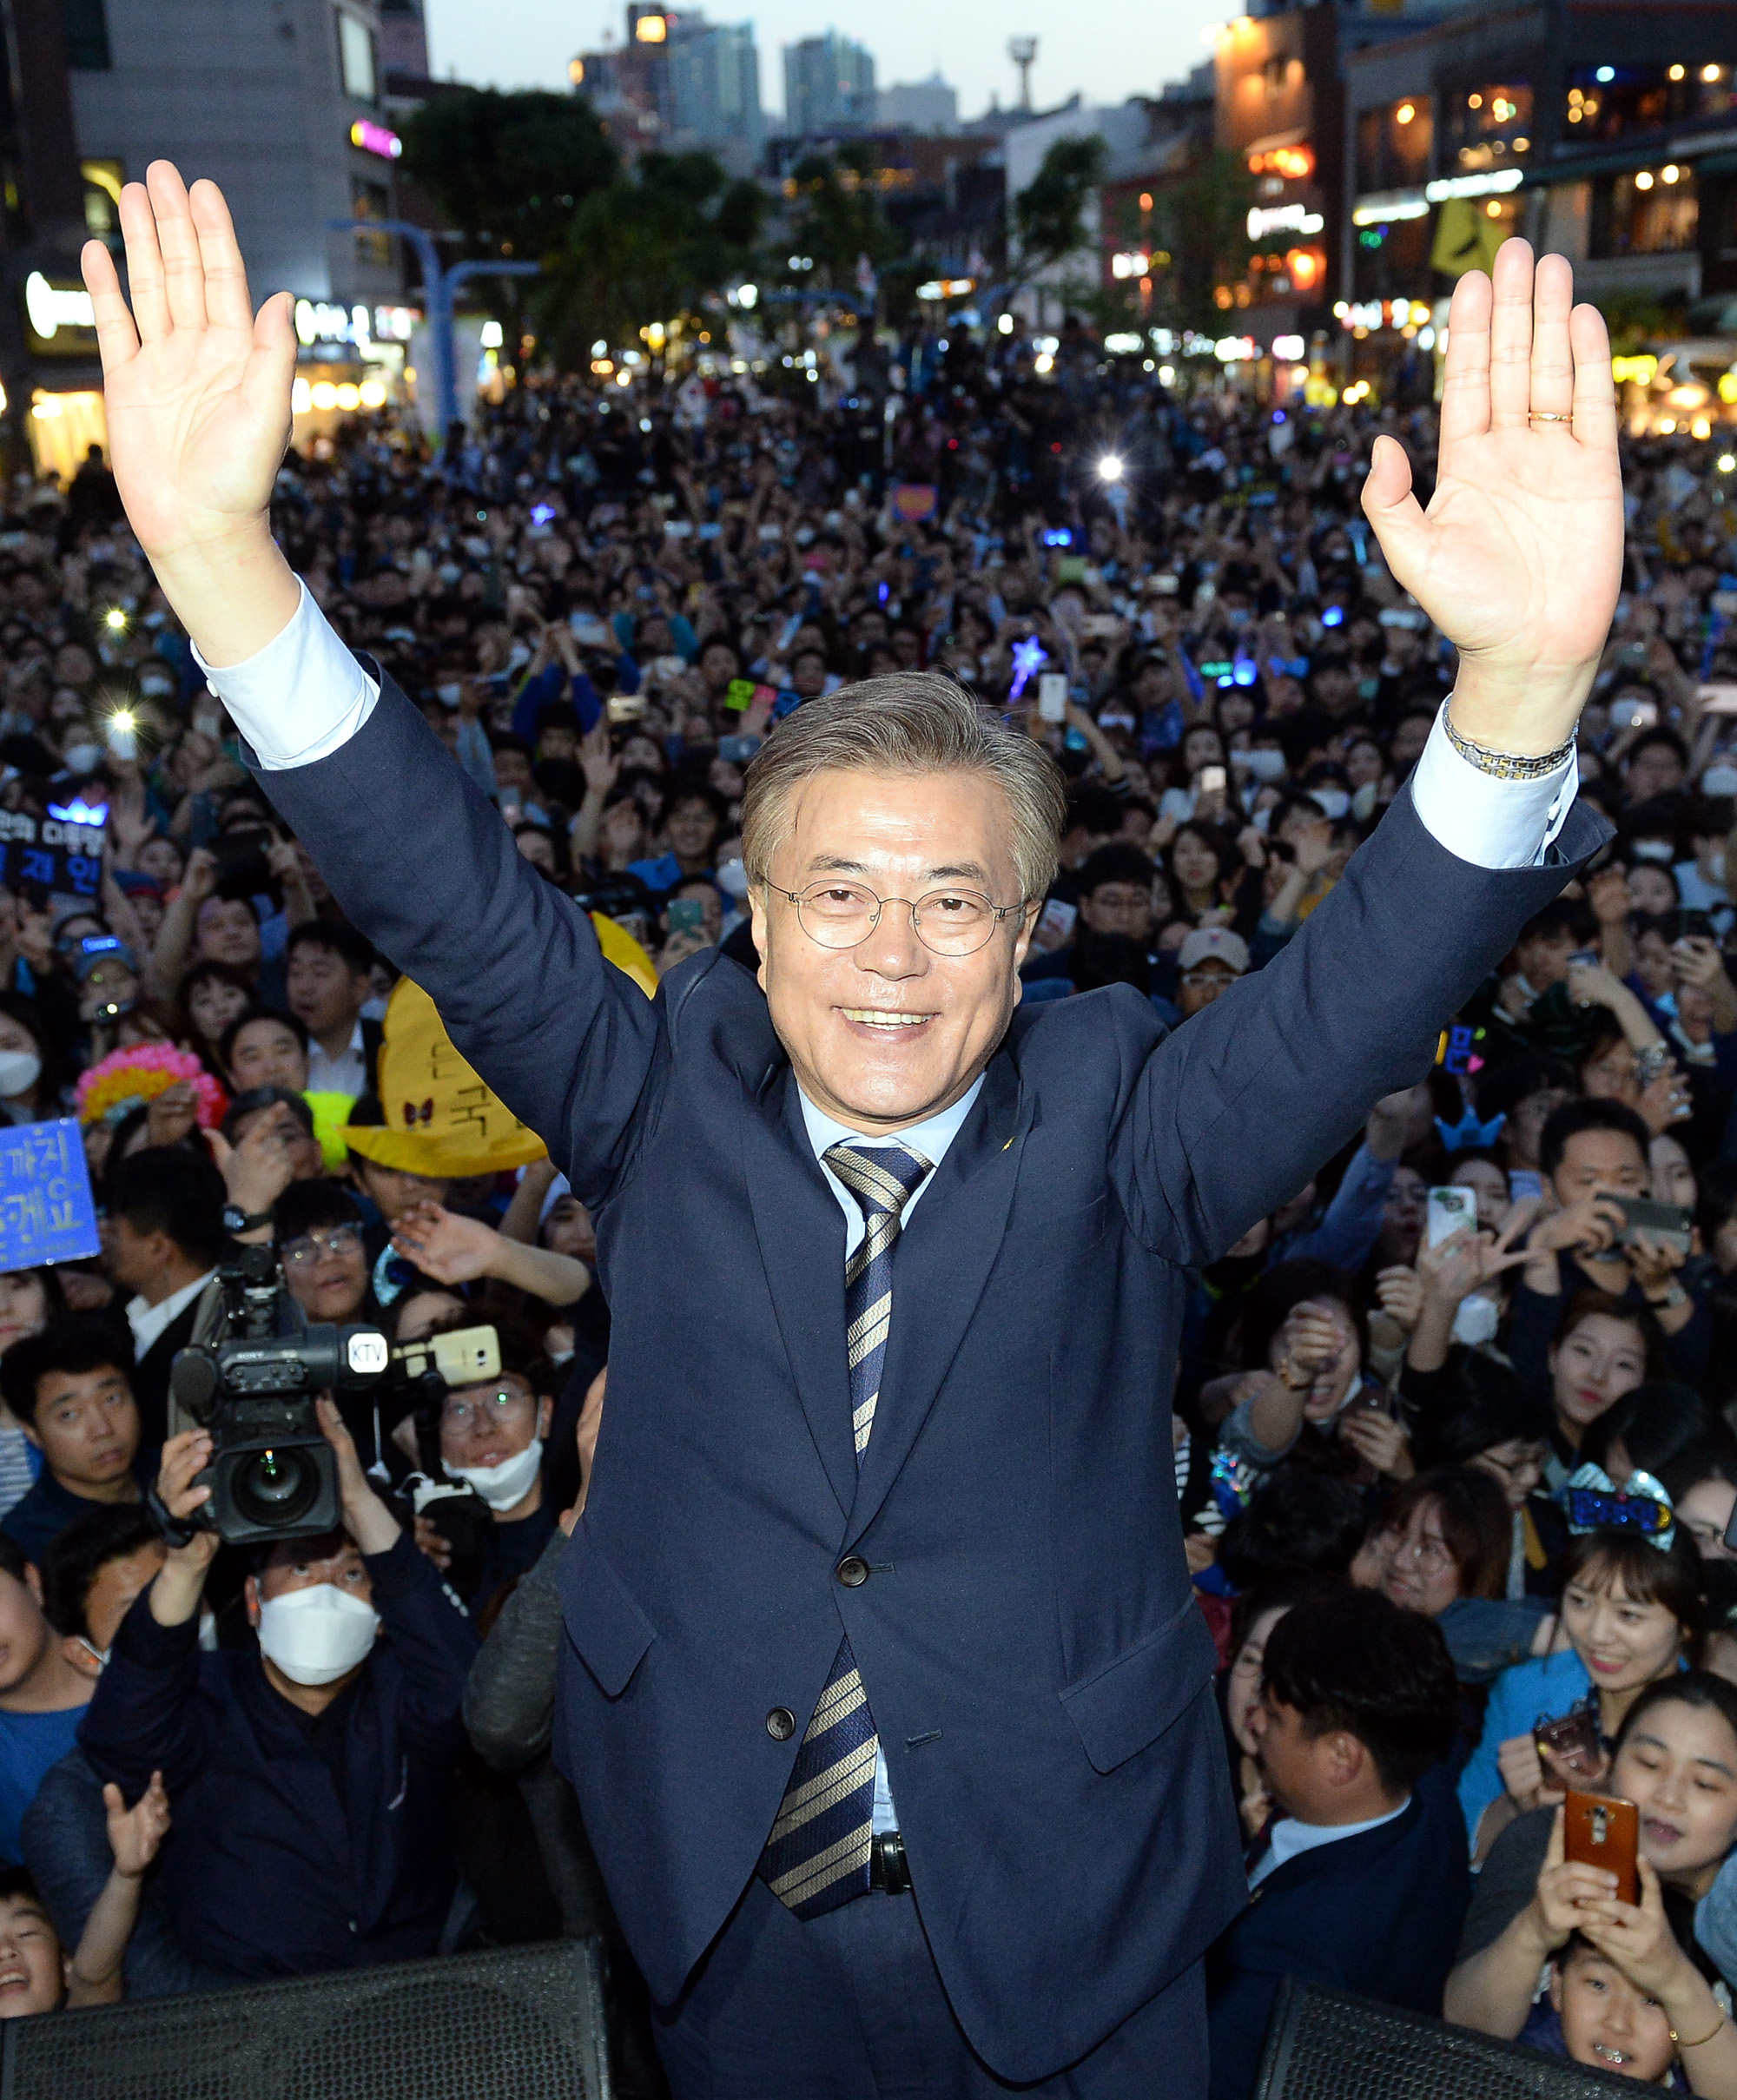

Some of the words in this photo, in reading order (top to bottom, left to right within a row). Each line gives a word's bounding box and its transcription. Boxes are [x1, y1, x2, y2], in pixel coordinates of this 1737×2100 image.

[0, 842, 101, 895] 재인
[0, 1130, 69, 1186] 까지
[352, 1344, 383, 1362] KTV
